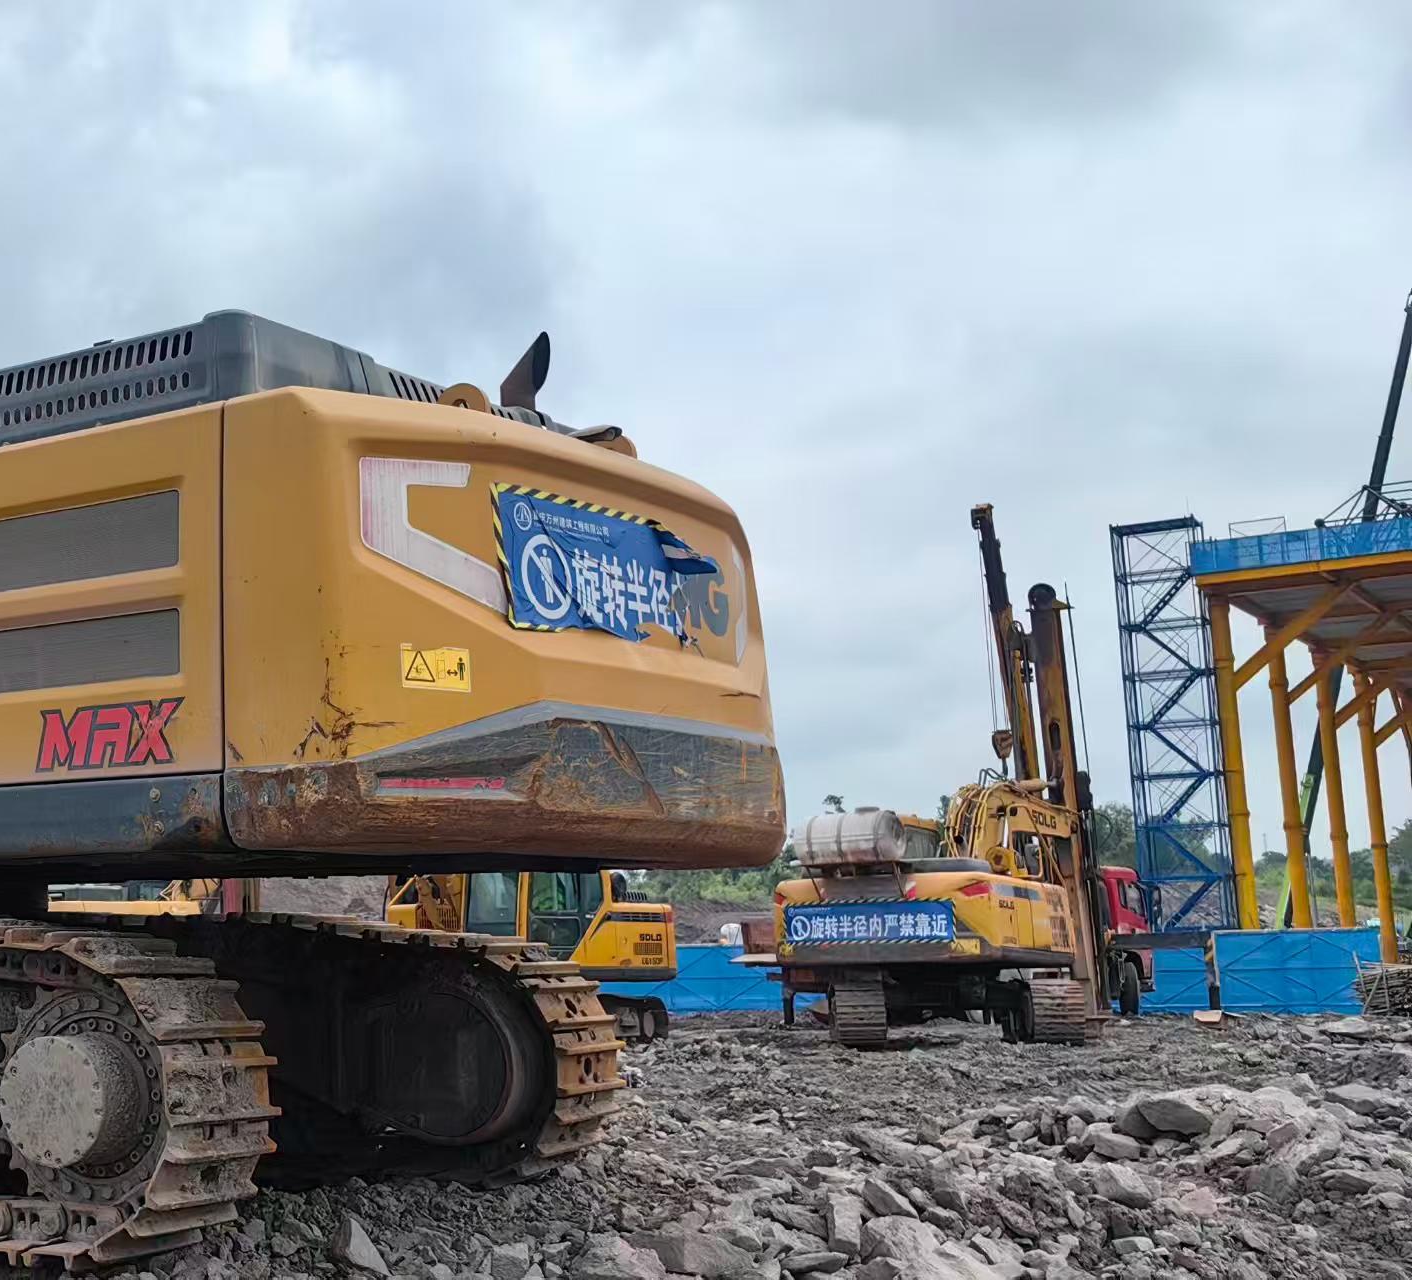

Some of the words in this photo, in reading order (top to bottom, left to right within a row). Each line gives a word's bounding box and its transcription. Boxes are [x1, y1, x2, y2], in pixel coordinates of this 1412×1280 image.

[572, 547, 683, 636] 旋转半径
[36, 696, 186, 773] MAX
[810, 913, 948, 939] 旋转半径内严禁靠近
